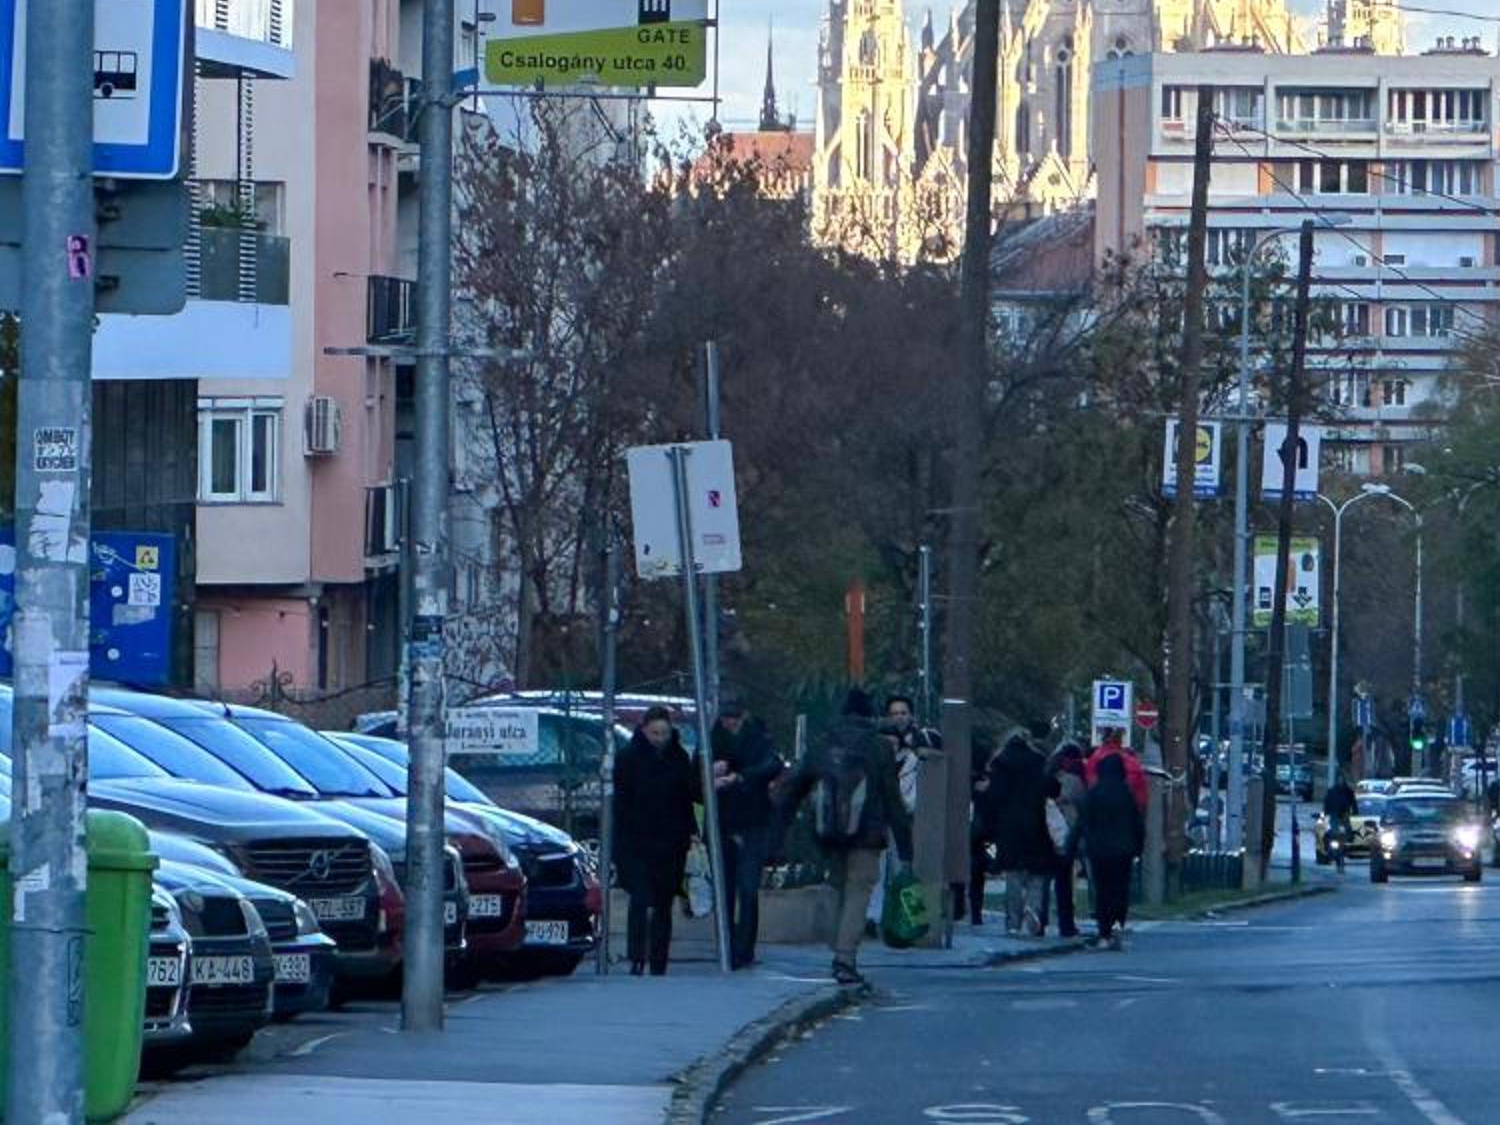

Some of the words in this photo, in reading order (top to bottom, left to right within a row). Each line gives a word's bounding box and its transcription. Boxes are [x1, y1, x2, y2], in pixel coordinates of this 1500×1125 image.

[637, 28, 690, 45] GATE
[500, 51, 606, 72] Csalogány
[613, 56, 656, 71] utca
